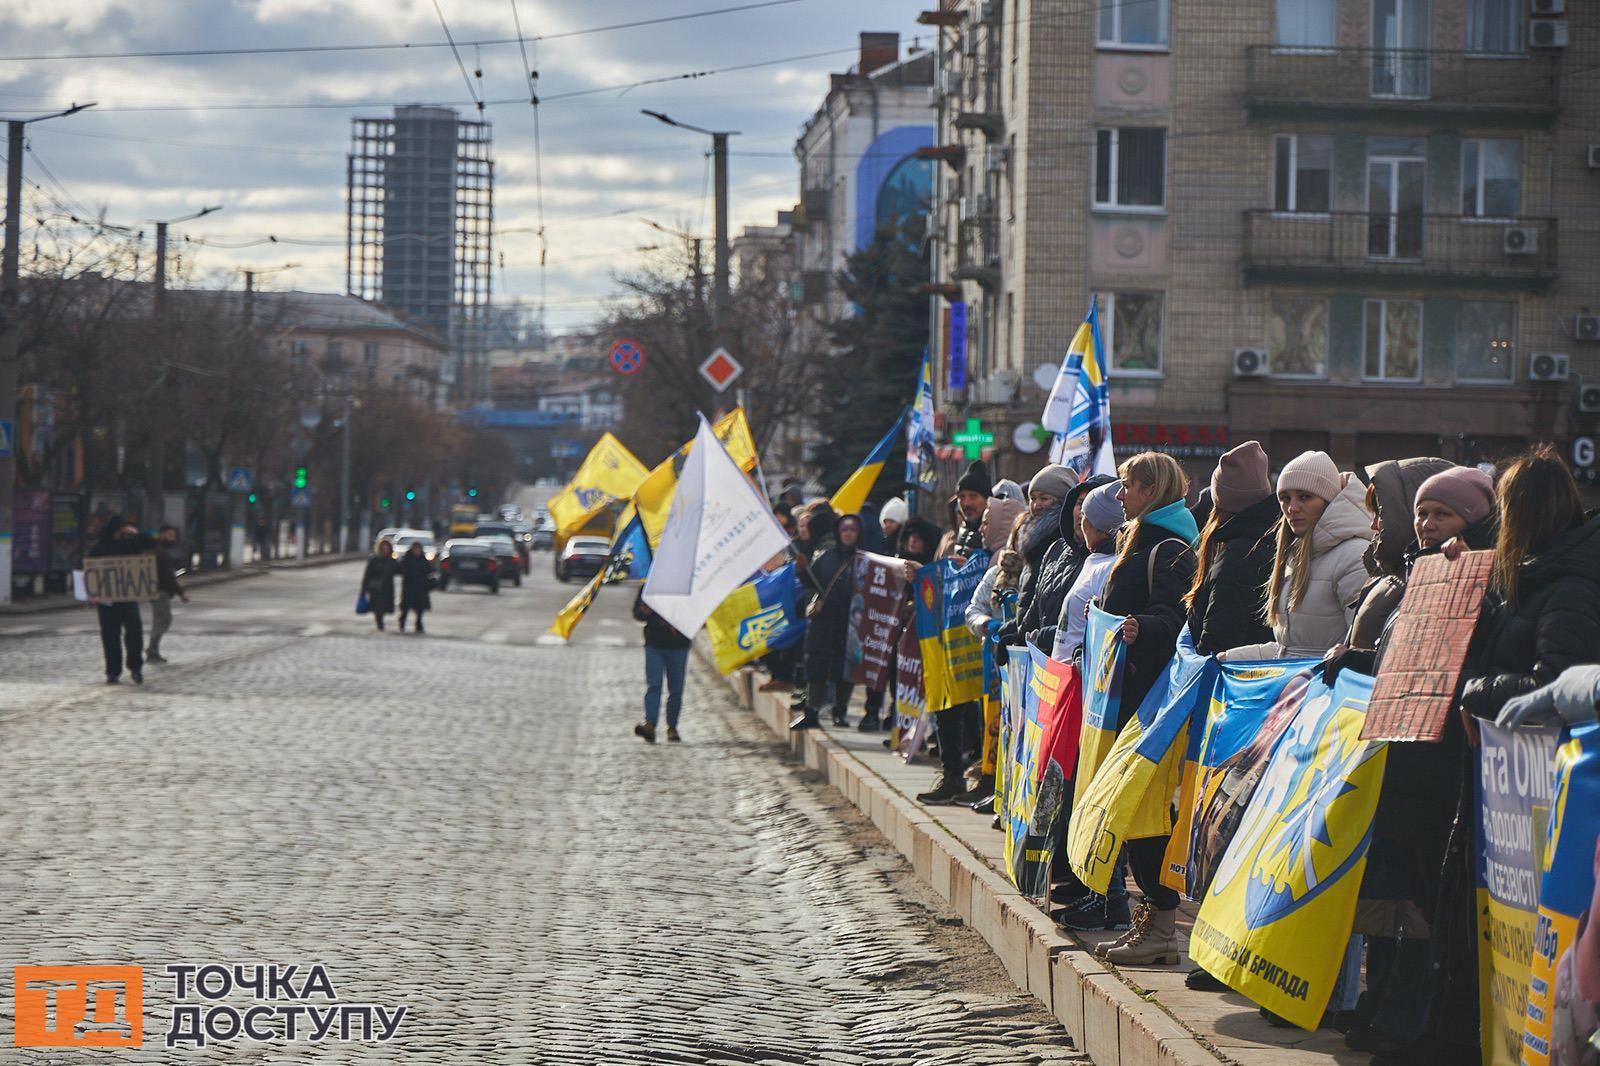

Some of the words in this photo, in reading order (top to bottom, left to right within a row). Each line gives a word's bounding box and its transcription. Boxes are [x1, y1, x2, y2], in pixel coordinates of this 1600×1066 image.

[1491, 811, 1532, 856] ДОДОМУ
[1494, 862, 1538, 907] БЕЗВІСТІ
[1249, 954, 1310, 1001] БРИГАДА
